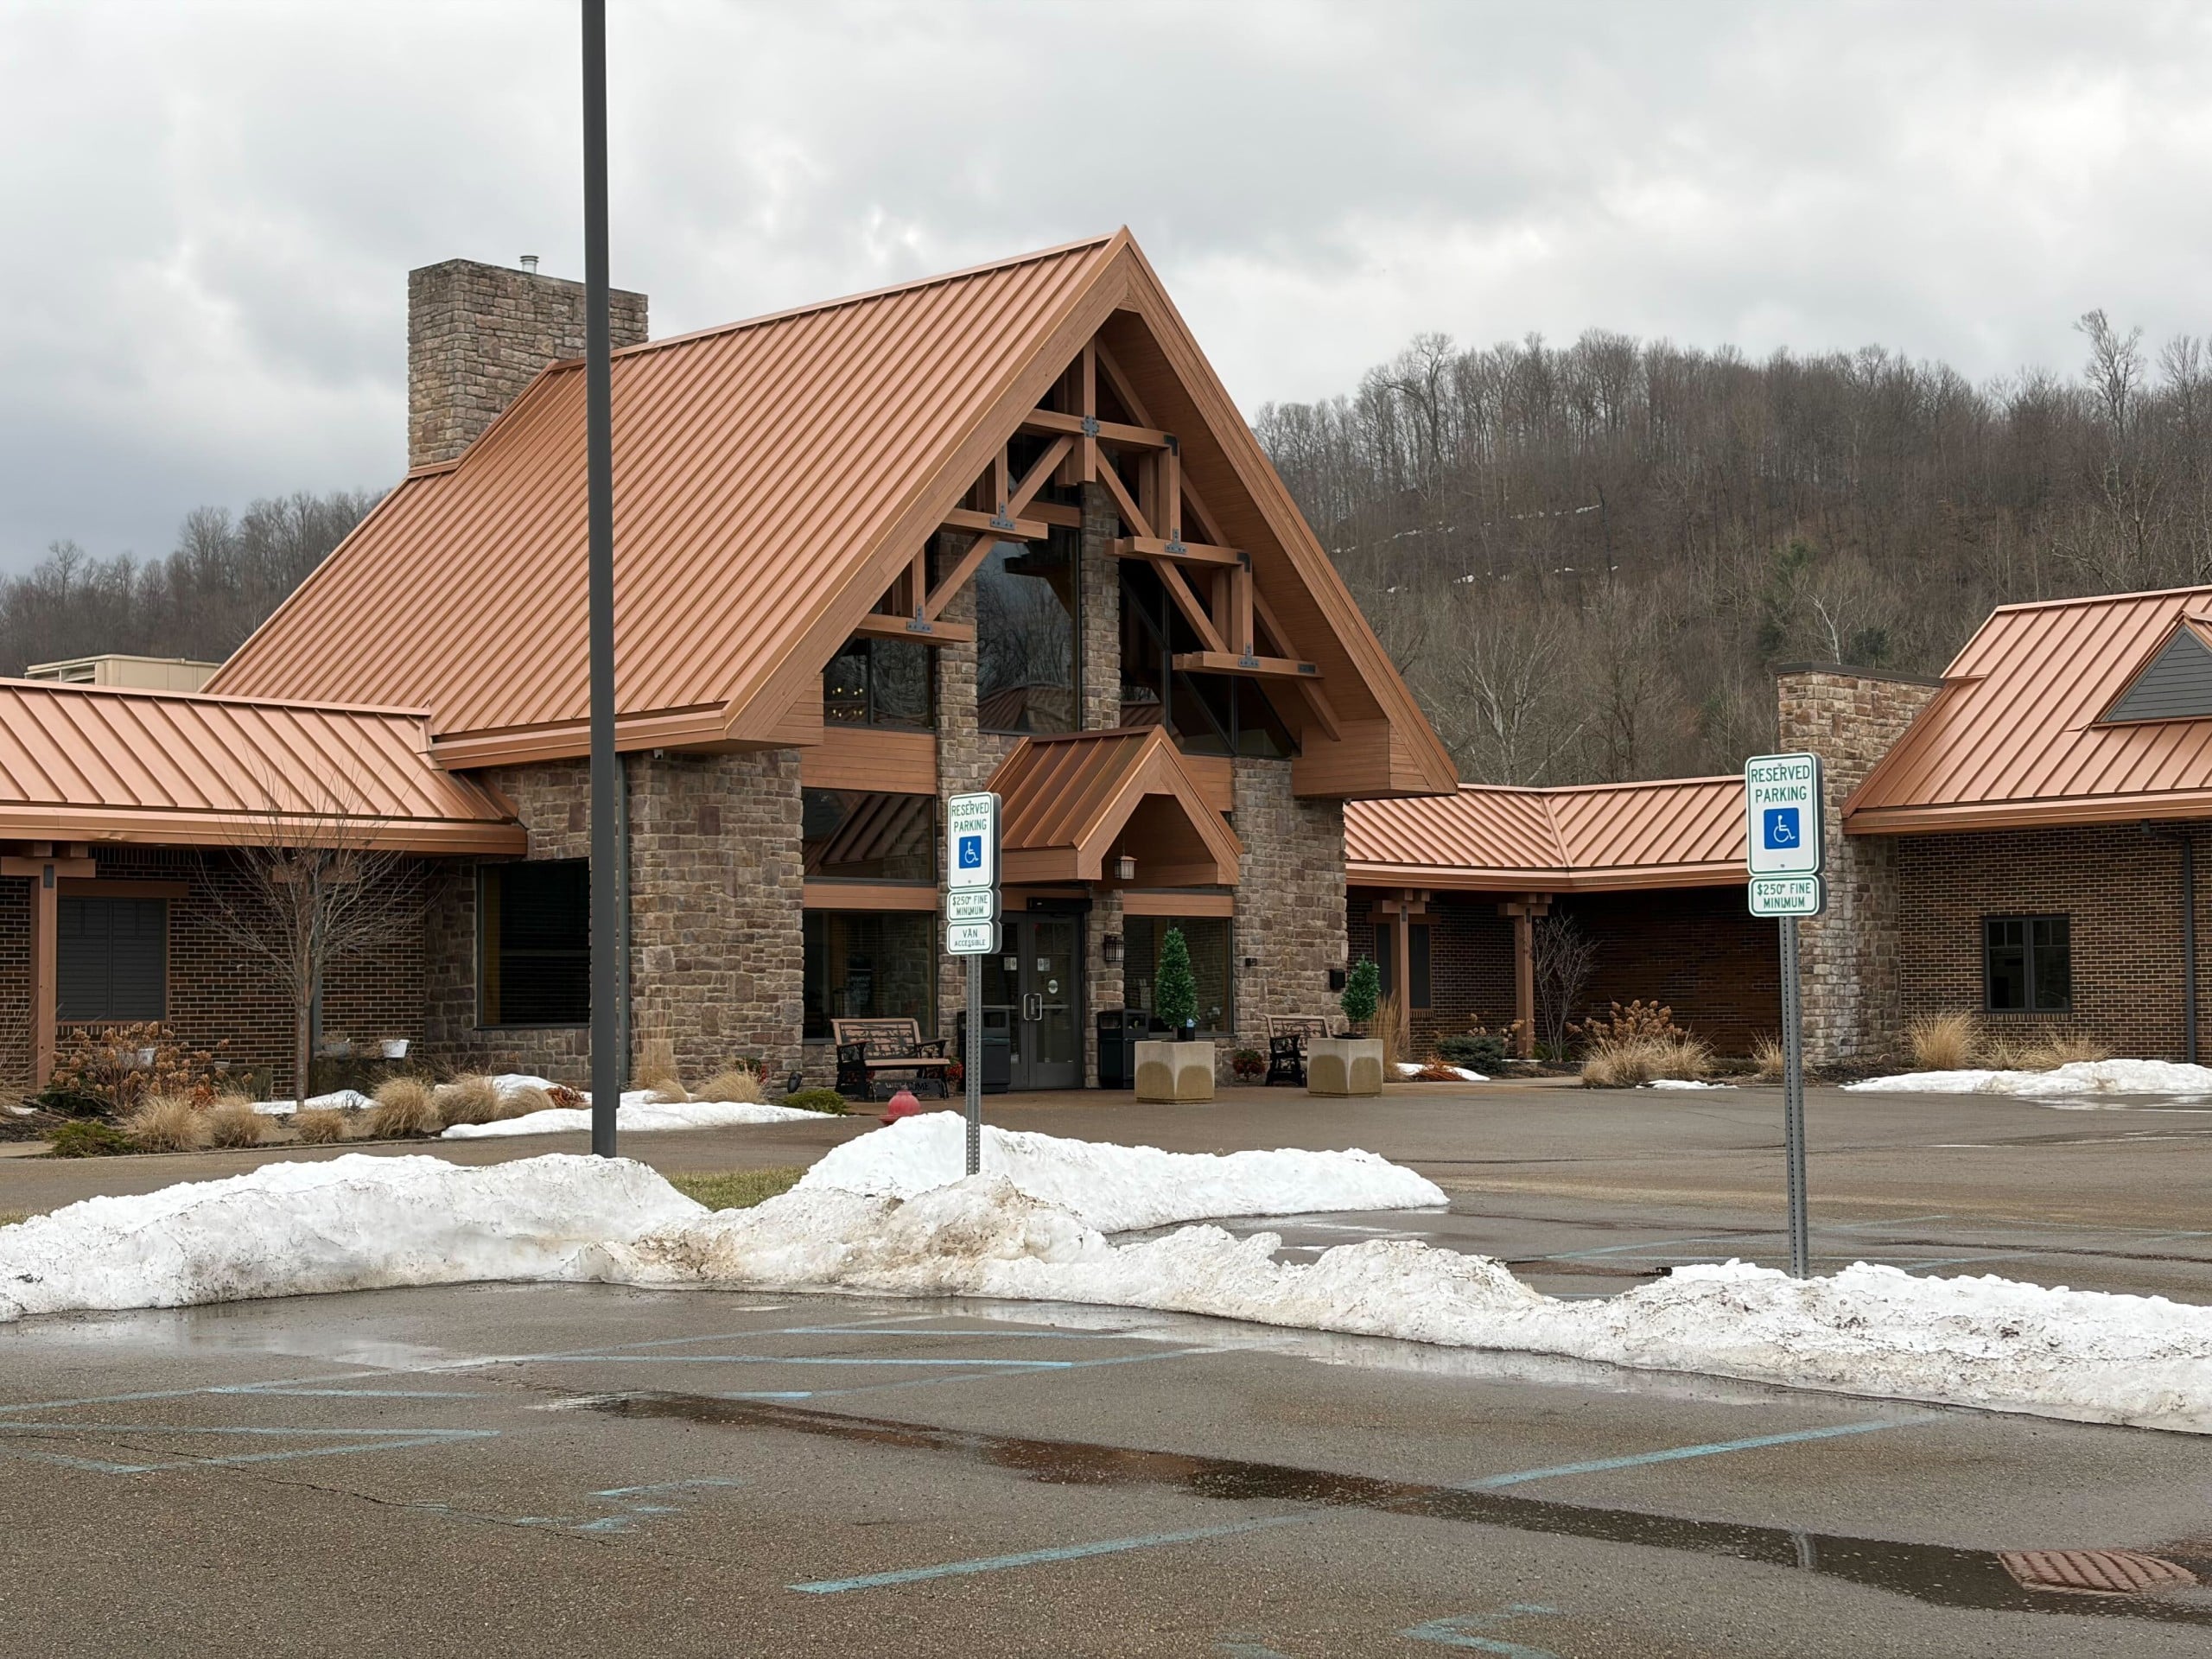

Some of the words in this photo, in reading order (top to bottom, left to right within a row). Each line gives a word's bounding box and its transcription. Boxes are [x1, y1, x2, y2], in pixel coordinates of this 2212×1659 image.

[1751, 766, 1809, 783] RESERVED
[1756, 786, 1807, 803] PARKING
[951, 802, 989, 817] RESERVED
[954, 819, 987, 833] PARKING
[1790, 882, 1811, 893] FINE
[974, 894, 988, 904] FINE
[1764, 897, 1805, 909] MINIMUM
[957, 906, 984, 916] MINIMUM
[963, 930, 977, 938] VAN
